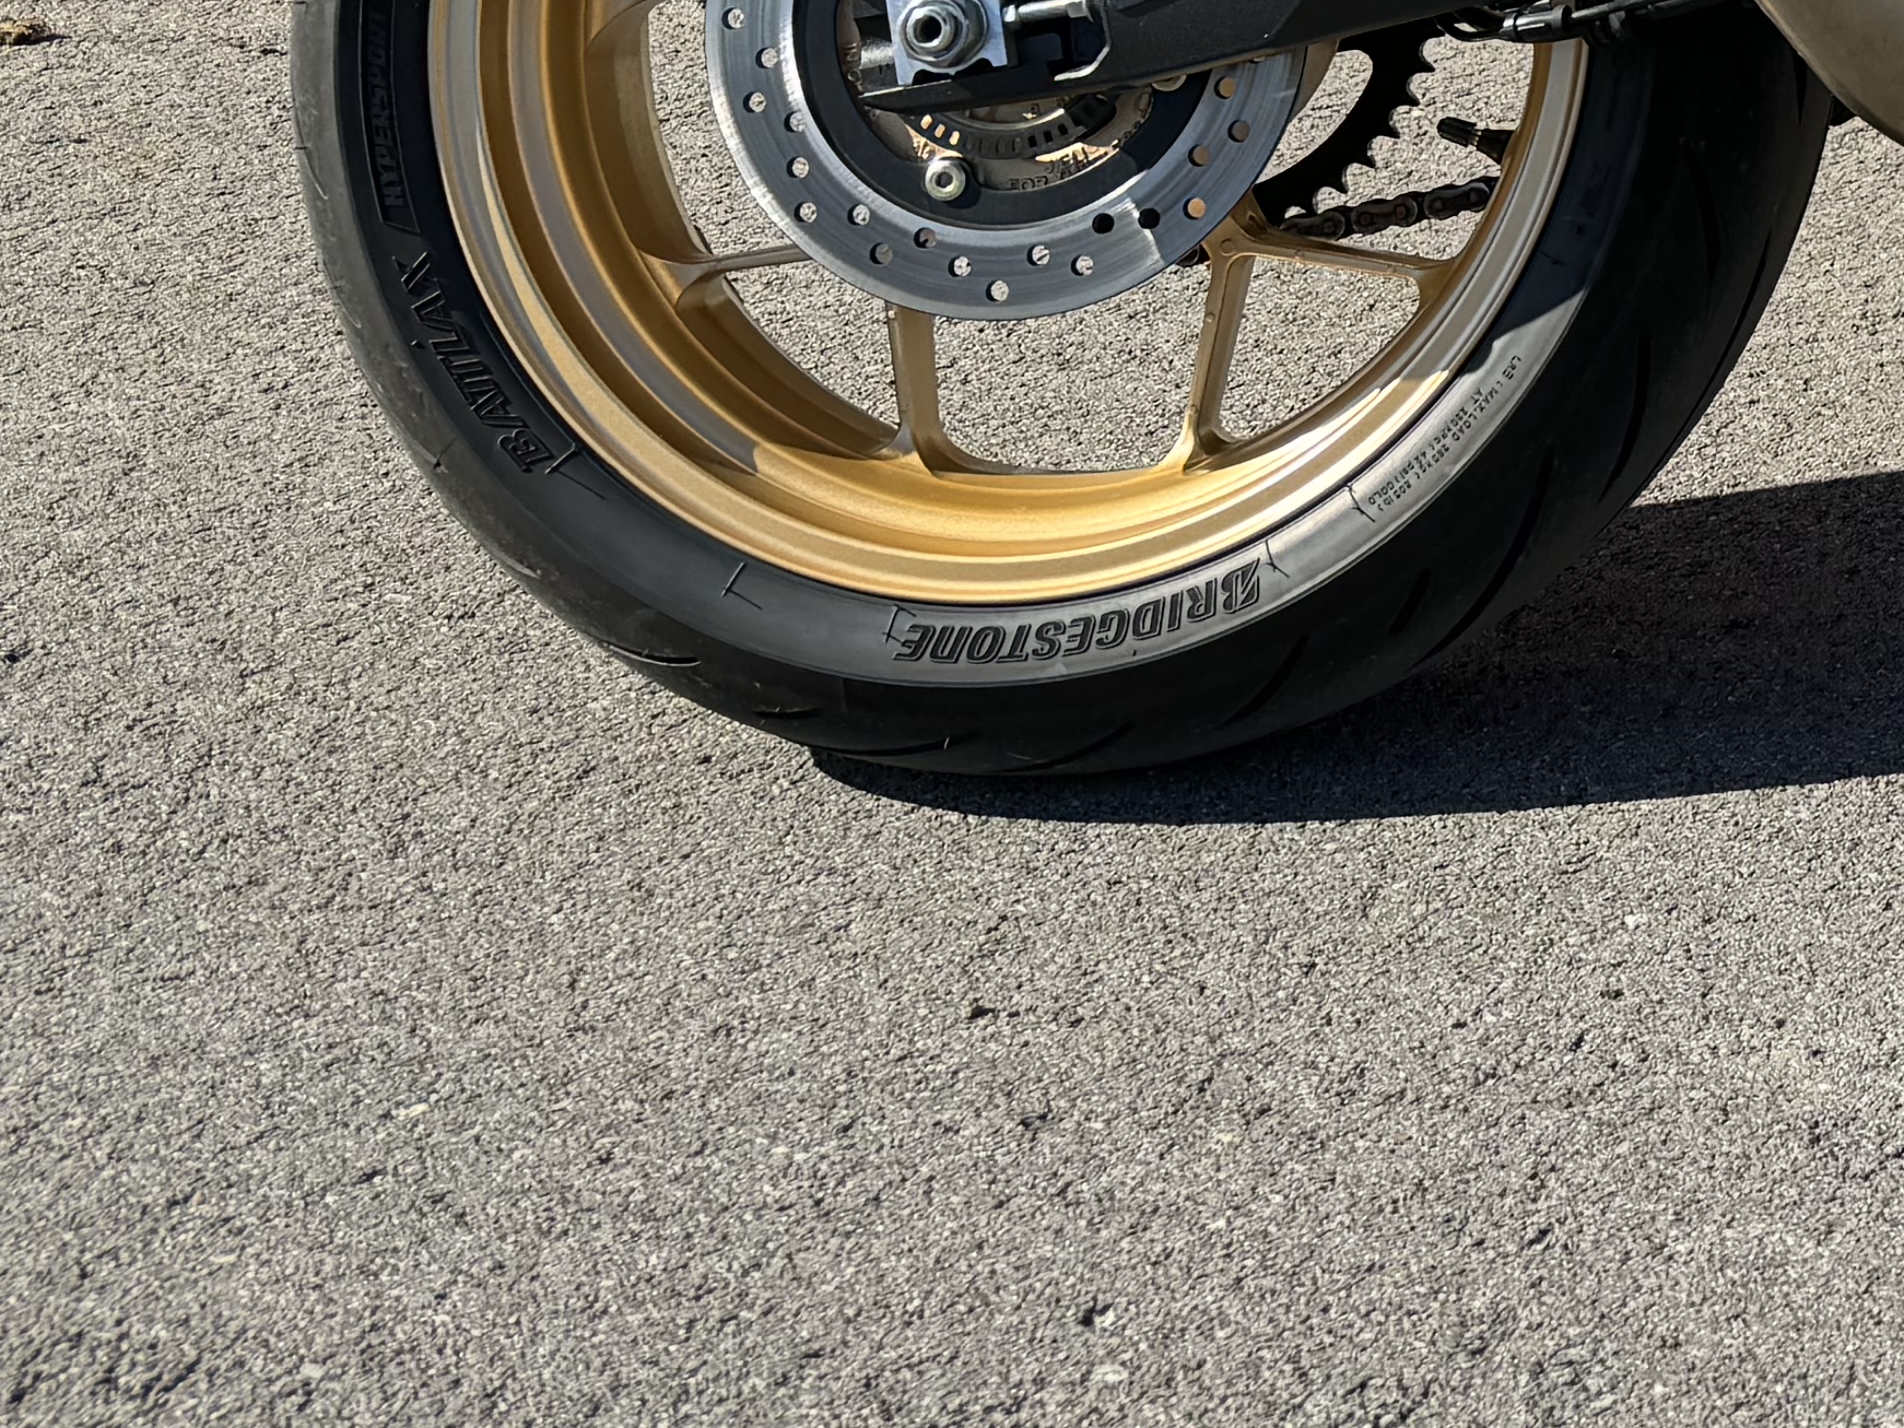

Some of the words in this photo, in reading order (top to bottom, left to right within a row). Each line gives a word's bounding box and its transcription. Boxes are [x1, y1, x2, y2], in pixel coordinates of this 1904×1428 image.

[393, 251, 552, 474] BATTLAX
[1470, 387, 1484, 405] AT
[894, 558, 1261, 664] BRIDGESTONE
